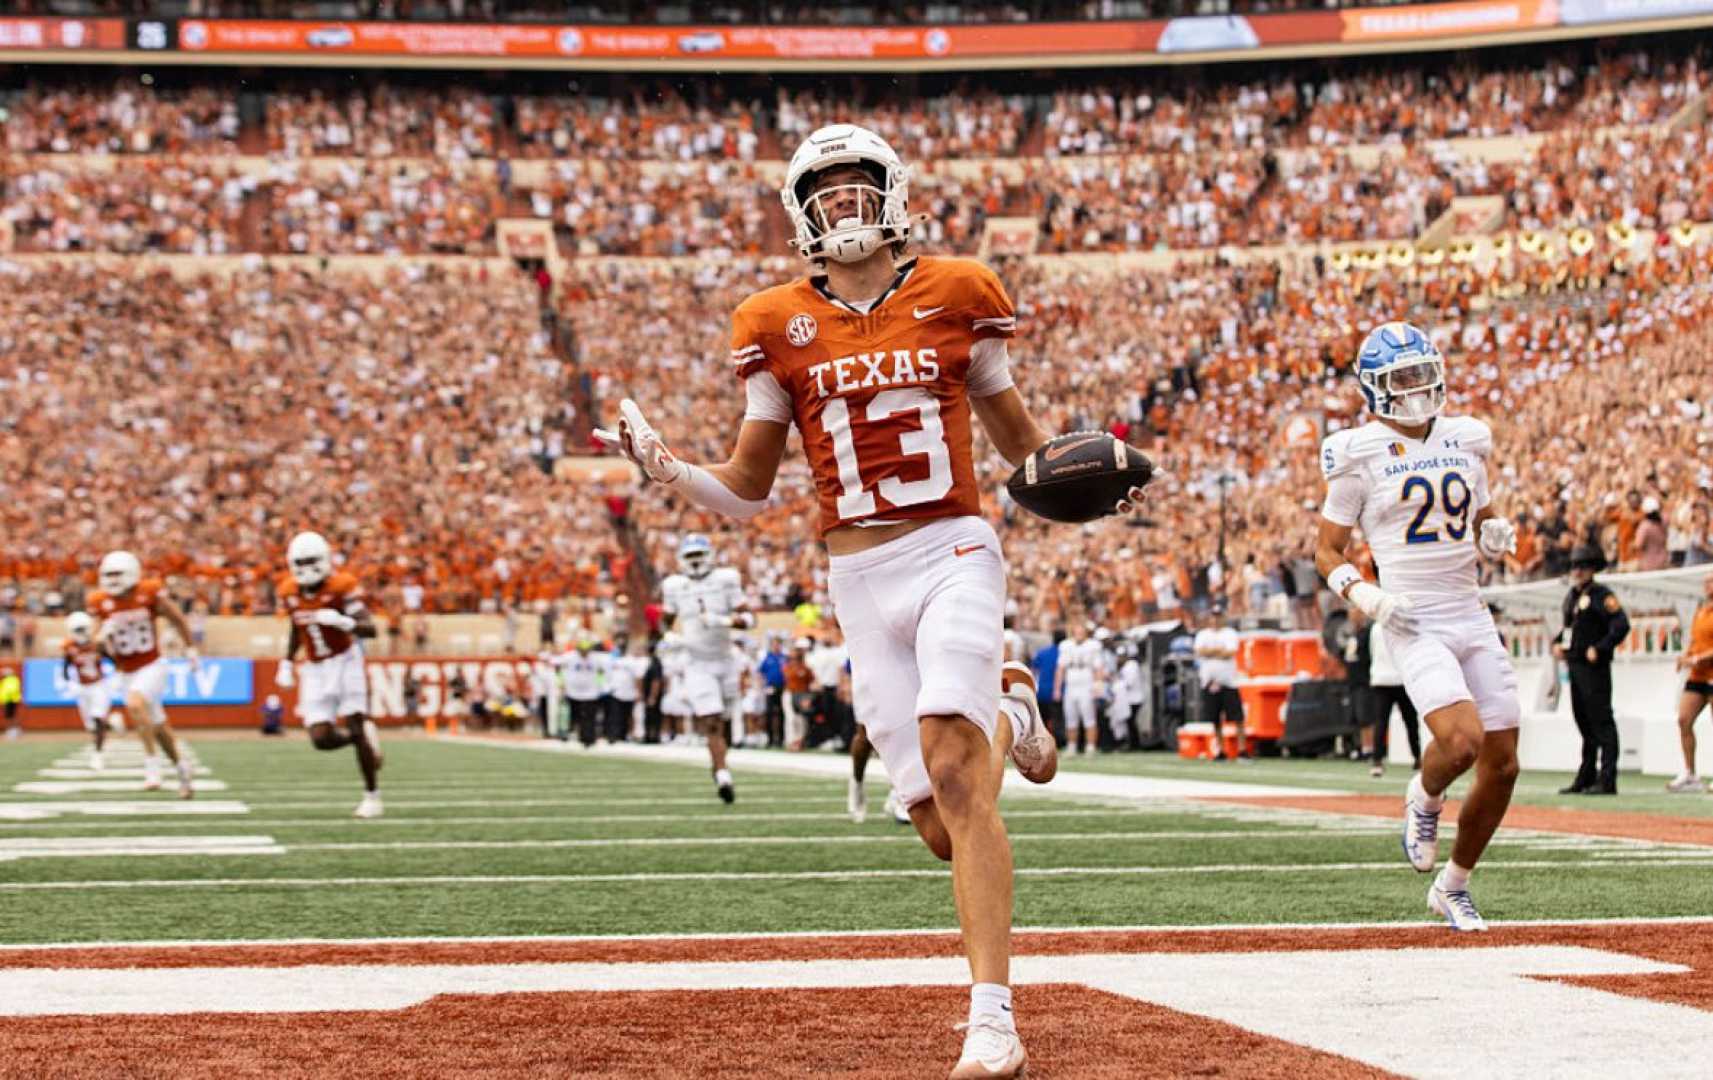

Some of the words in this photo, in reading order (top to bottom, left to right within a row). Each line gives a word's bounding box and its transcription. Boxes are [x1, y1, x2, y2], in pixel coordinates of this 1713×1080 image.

[788, 315, 815, 344] SEC
[808, 348, 940, 398] TEXAS
[820, 387, 953, 519] 13
[1384, 462, 1409, 477] SAN
[1411, 456, 1440, 471] JOSÉ
[1400, 470, 1471, 545] 29
[307, 624, 331, 656] 1
